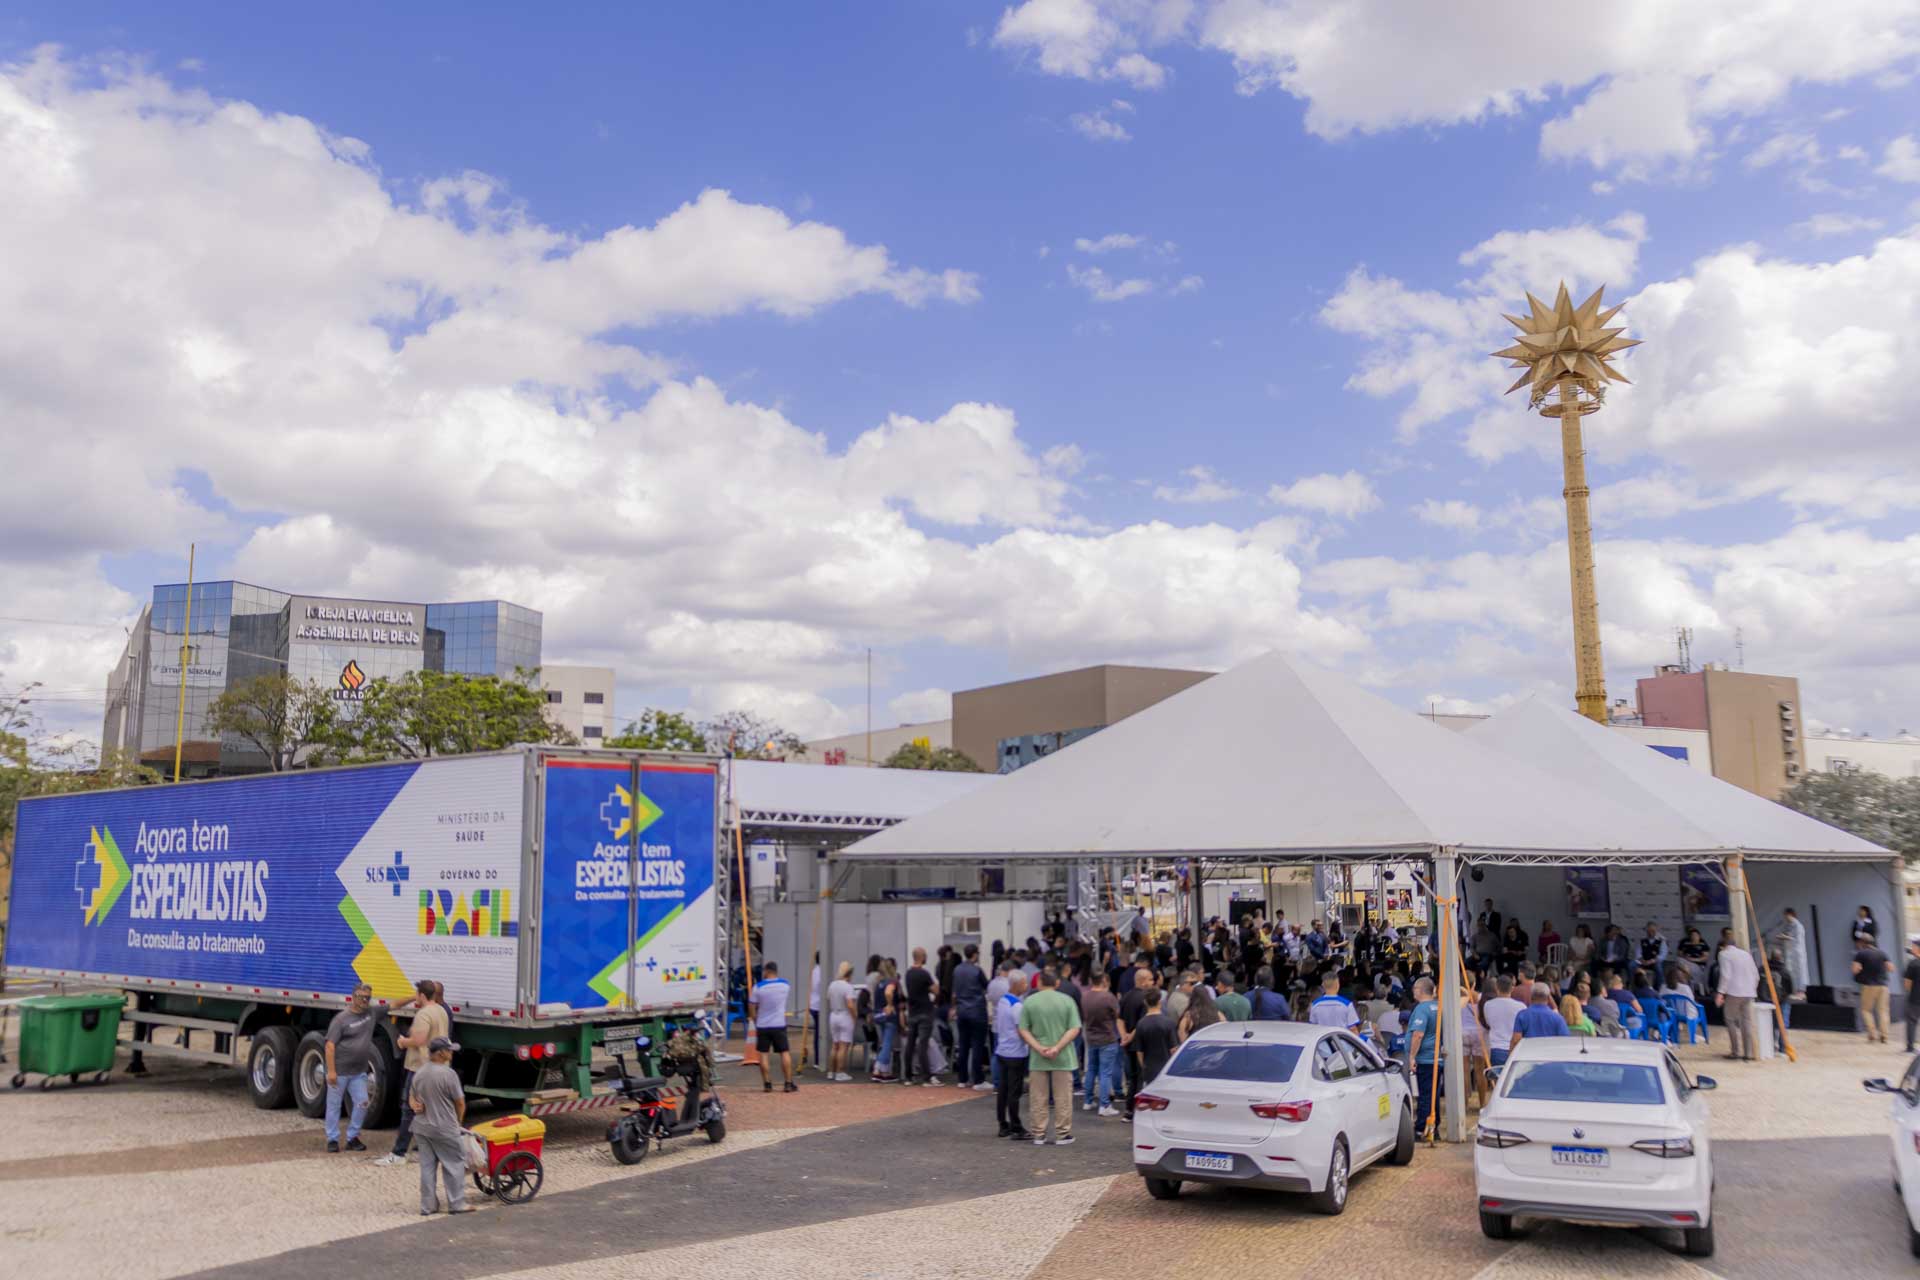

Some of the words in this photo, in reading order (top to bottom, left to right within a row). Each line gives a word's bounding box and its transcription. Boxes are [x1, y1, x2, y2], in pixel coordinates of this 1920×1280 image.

[306, 604, 346, 620] IGREJA
[297, 624, 369, 641] ASSEMBLEIA
[372, 628, 388, 642] DE
[390, 630, 420, 644] DEUS
[494, 811, 505, 822] DA
[134, 821, 187, 862] Agora
[192, 818, 229, 852] tem
[593, 842, 634, 861] Agor
[642, 842, 671, 858] tem
[366, 866, 385, 883] SUS
[440, 870, 481, 880] GOVERNO
[486, 870, 498, 879] DO
[130, 860, 269, 921] ESPECIALISTAS
[418, 889, 518, 937] BRASIL
[128, 928, 141, 947] Da
[142, 930, 185, 950] consulta
[187, 935, 201, 951] ao
[202, 932, 265, 954] tratamento
